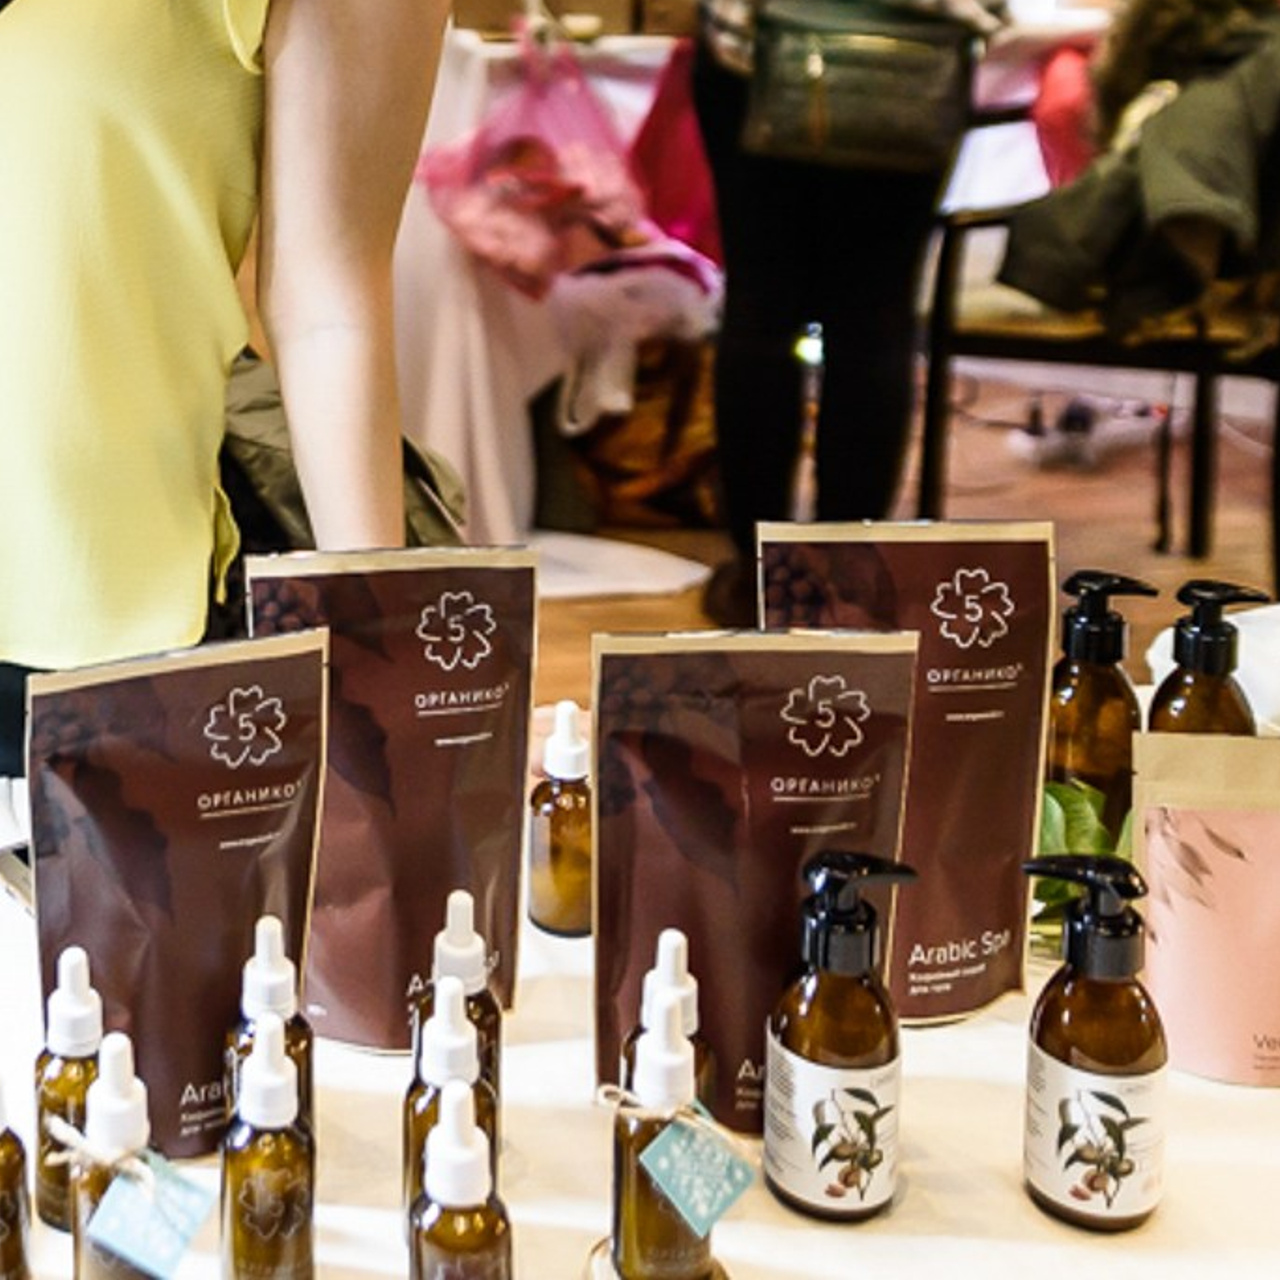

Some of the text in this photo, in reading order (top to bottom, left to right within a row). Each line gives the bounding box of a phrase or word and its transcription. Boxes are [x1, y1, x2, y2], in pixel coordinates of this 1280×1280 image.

[964, 594, 983, 623] 5
[448, 614, 465, 642] 5
[238, 713, 257, 741] 5
[815, 699, 836, 729] 5
[907, 940, 978, 967] Arabic
